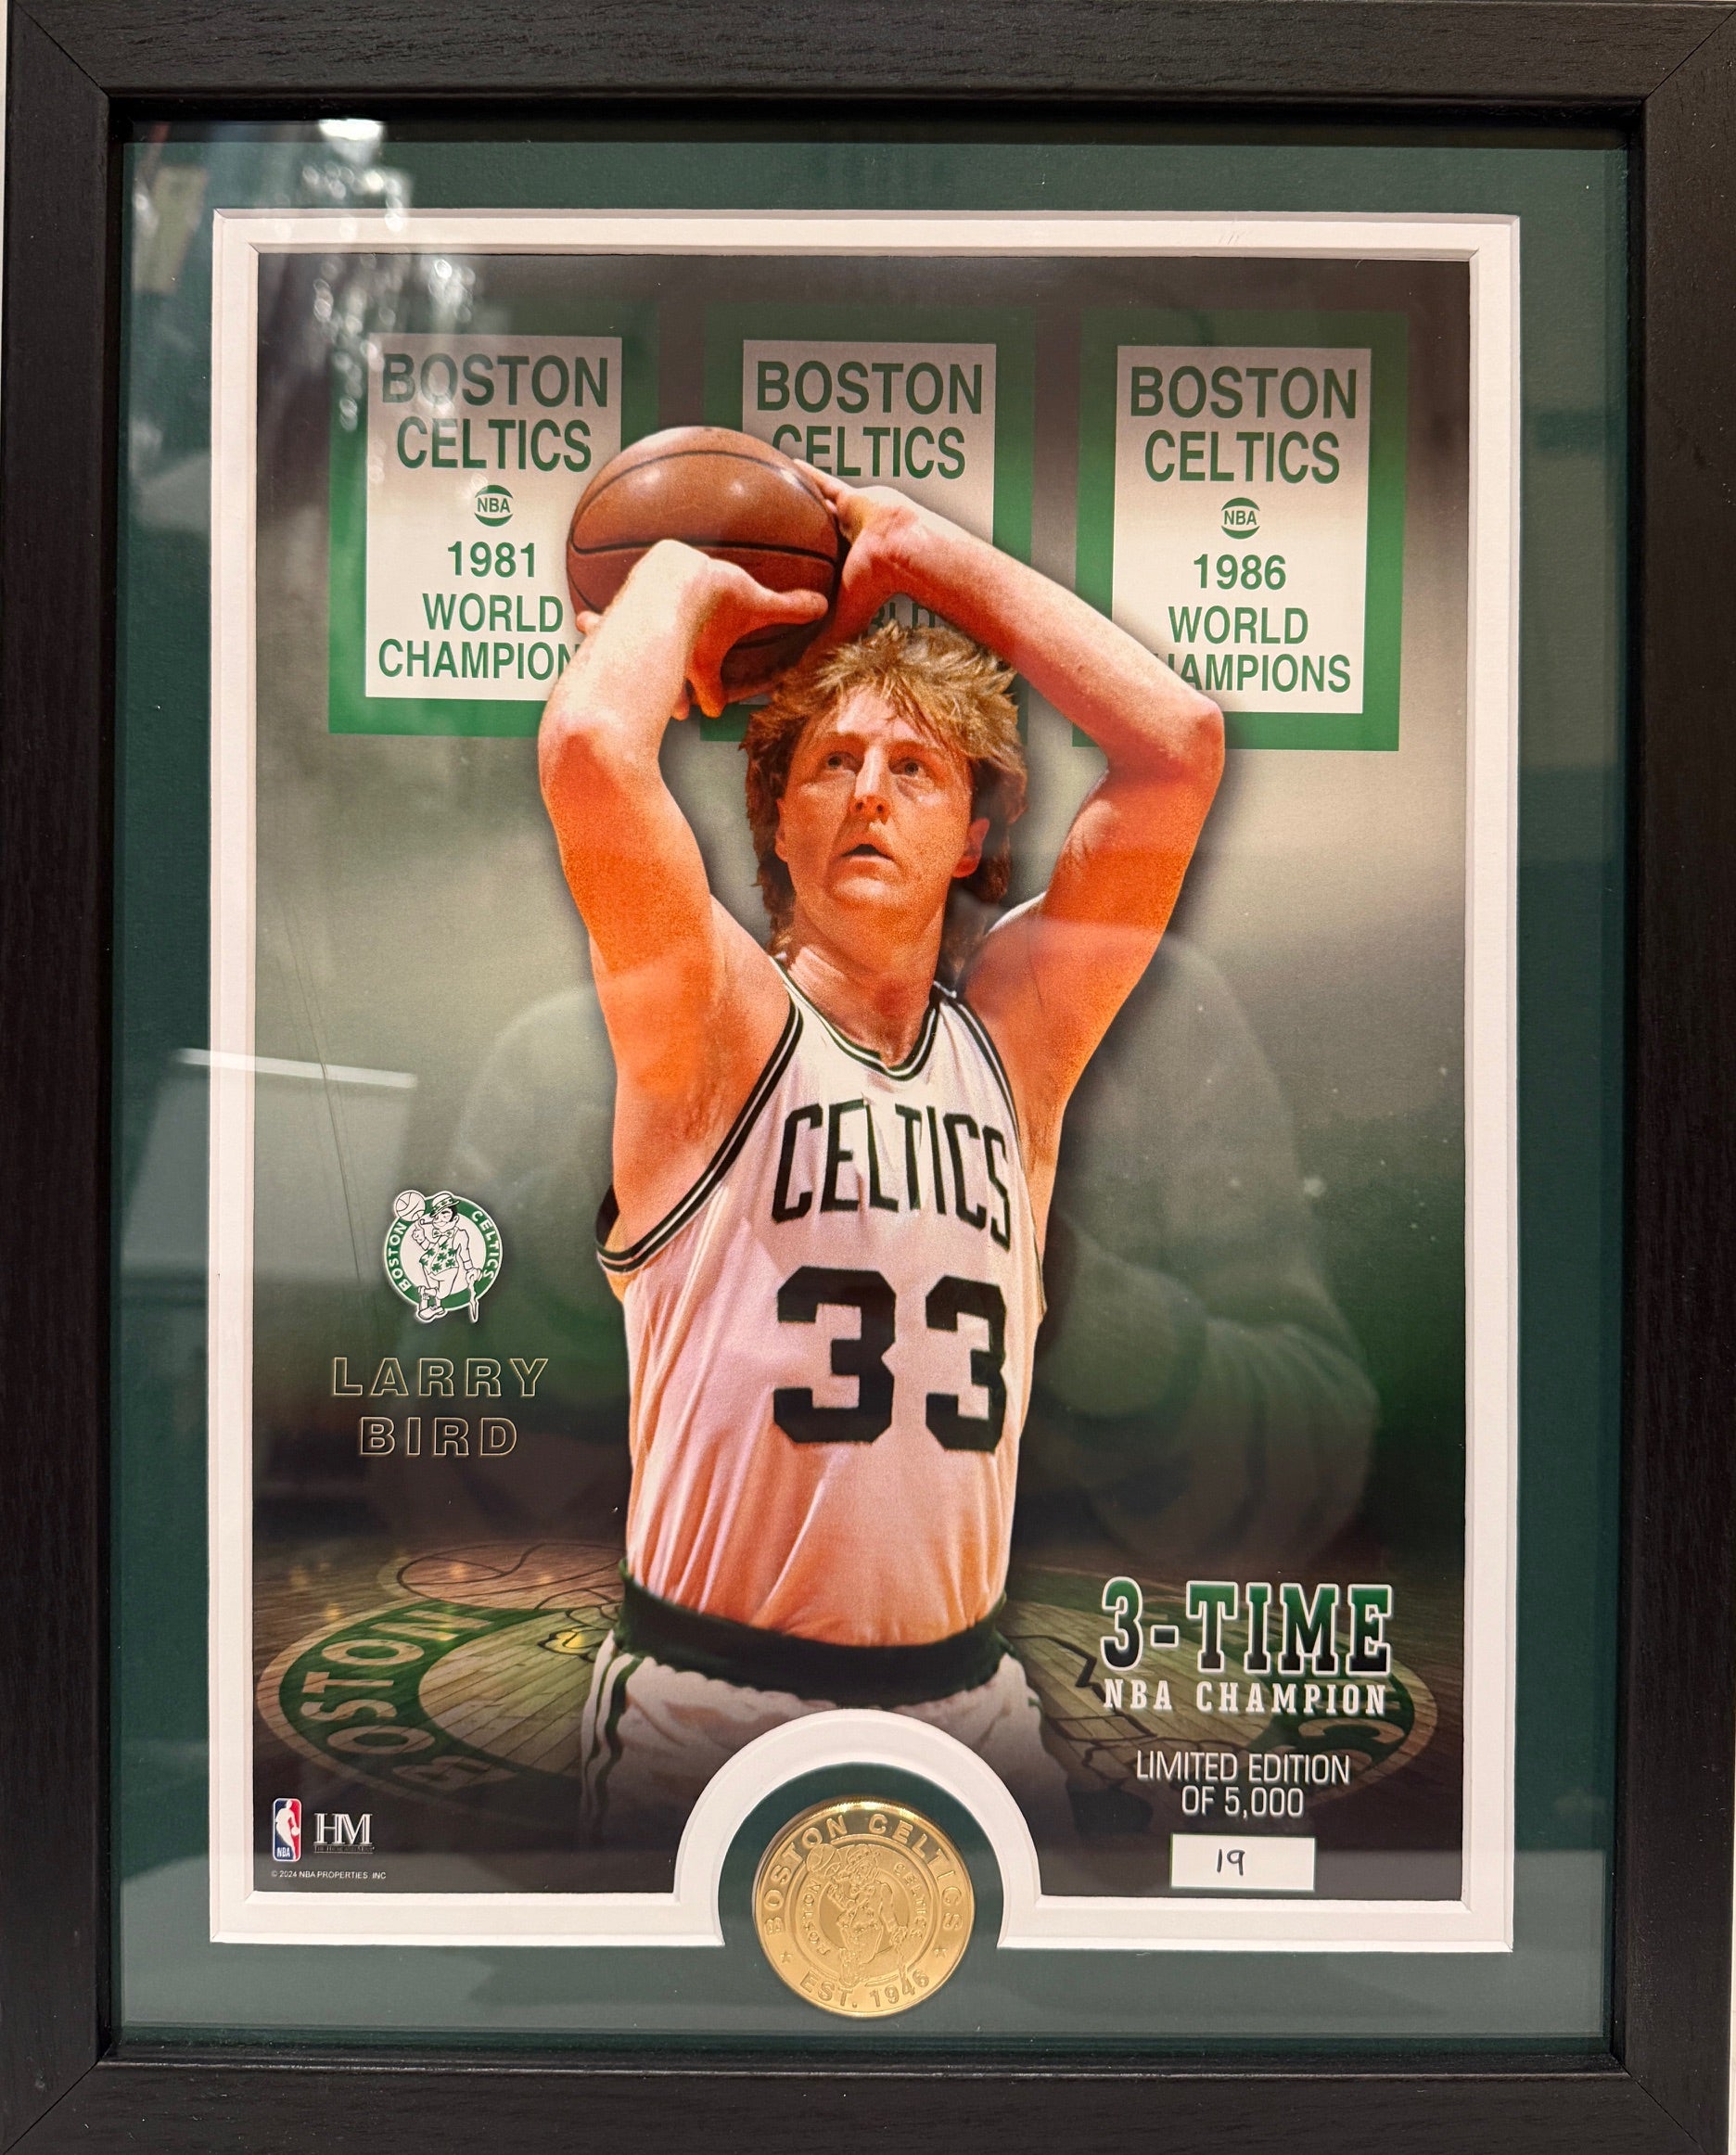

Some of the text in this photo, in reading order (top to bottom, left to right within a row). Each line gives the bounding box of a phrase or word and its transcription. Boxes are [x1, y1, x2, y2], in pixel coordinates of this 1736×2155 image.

[381, 354, 608, 409] BOSTON
[757, 360, 983, 414] BOSTON
[1130, 365, 1358, 419] BOSTON
[396, 417, 592, 472] CELTICS
[1144, 429, 1340, 484] CELTICS
[477, 497, 512, 515] NBA
[1223, 510, 1257, 526] NBA
[447, 542, 536, 578] 1981
[1194, 554, 1286, 590] 1986
[423, 593, 563, 632] WORLD
[1168, 605, 1308, 644] WORLD
[1154, 653, 1351, 693] AMPIONS
[772, 1098, 1011, 1252] CELTICS
[388, 1210, 500, 1292] BOSTON CELTICS
[333, 1357, 549, 1396] LARRY
[773, 1266, 1007, 1454] 33
[359, 1416, 518, 1457] BIRD
[1101, 1576, 1393, 1677] 3-TIME
[1103, 1678, 1385, 1715] NBA CHAMPION
[1136, 1750, 1350, 1786] LIMITED EDITION
[1181, 1784, 1304, 1820] OF 5,000
[313, 1813, 373, 1844] HM
[276, 1846, 290, 1857] NBA
[1216, 1848, 1245, 1877] 19
[279, 1870, 297, 1879] 2024
[299, 1870, 315, 1879] NBA
[764, 1813, 964, 1936] BOSTON CELTICS
[799, 1969, 930, 2009] EST. 1946
